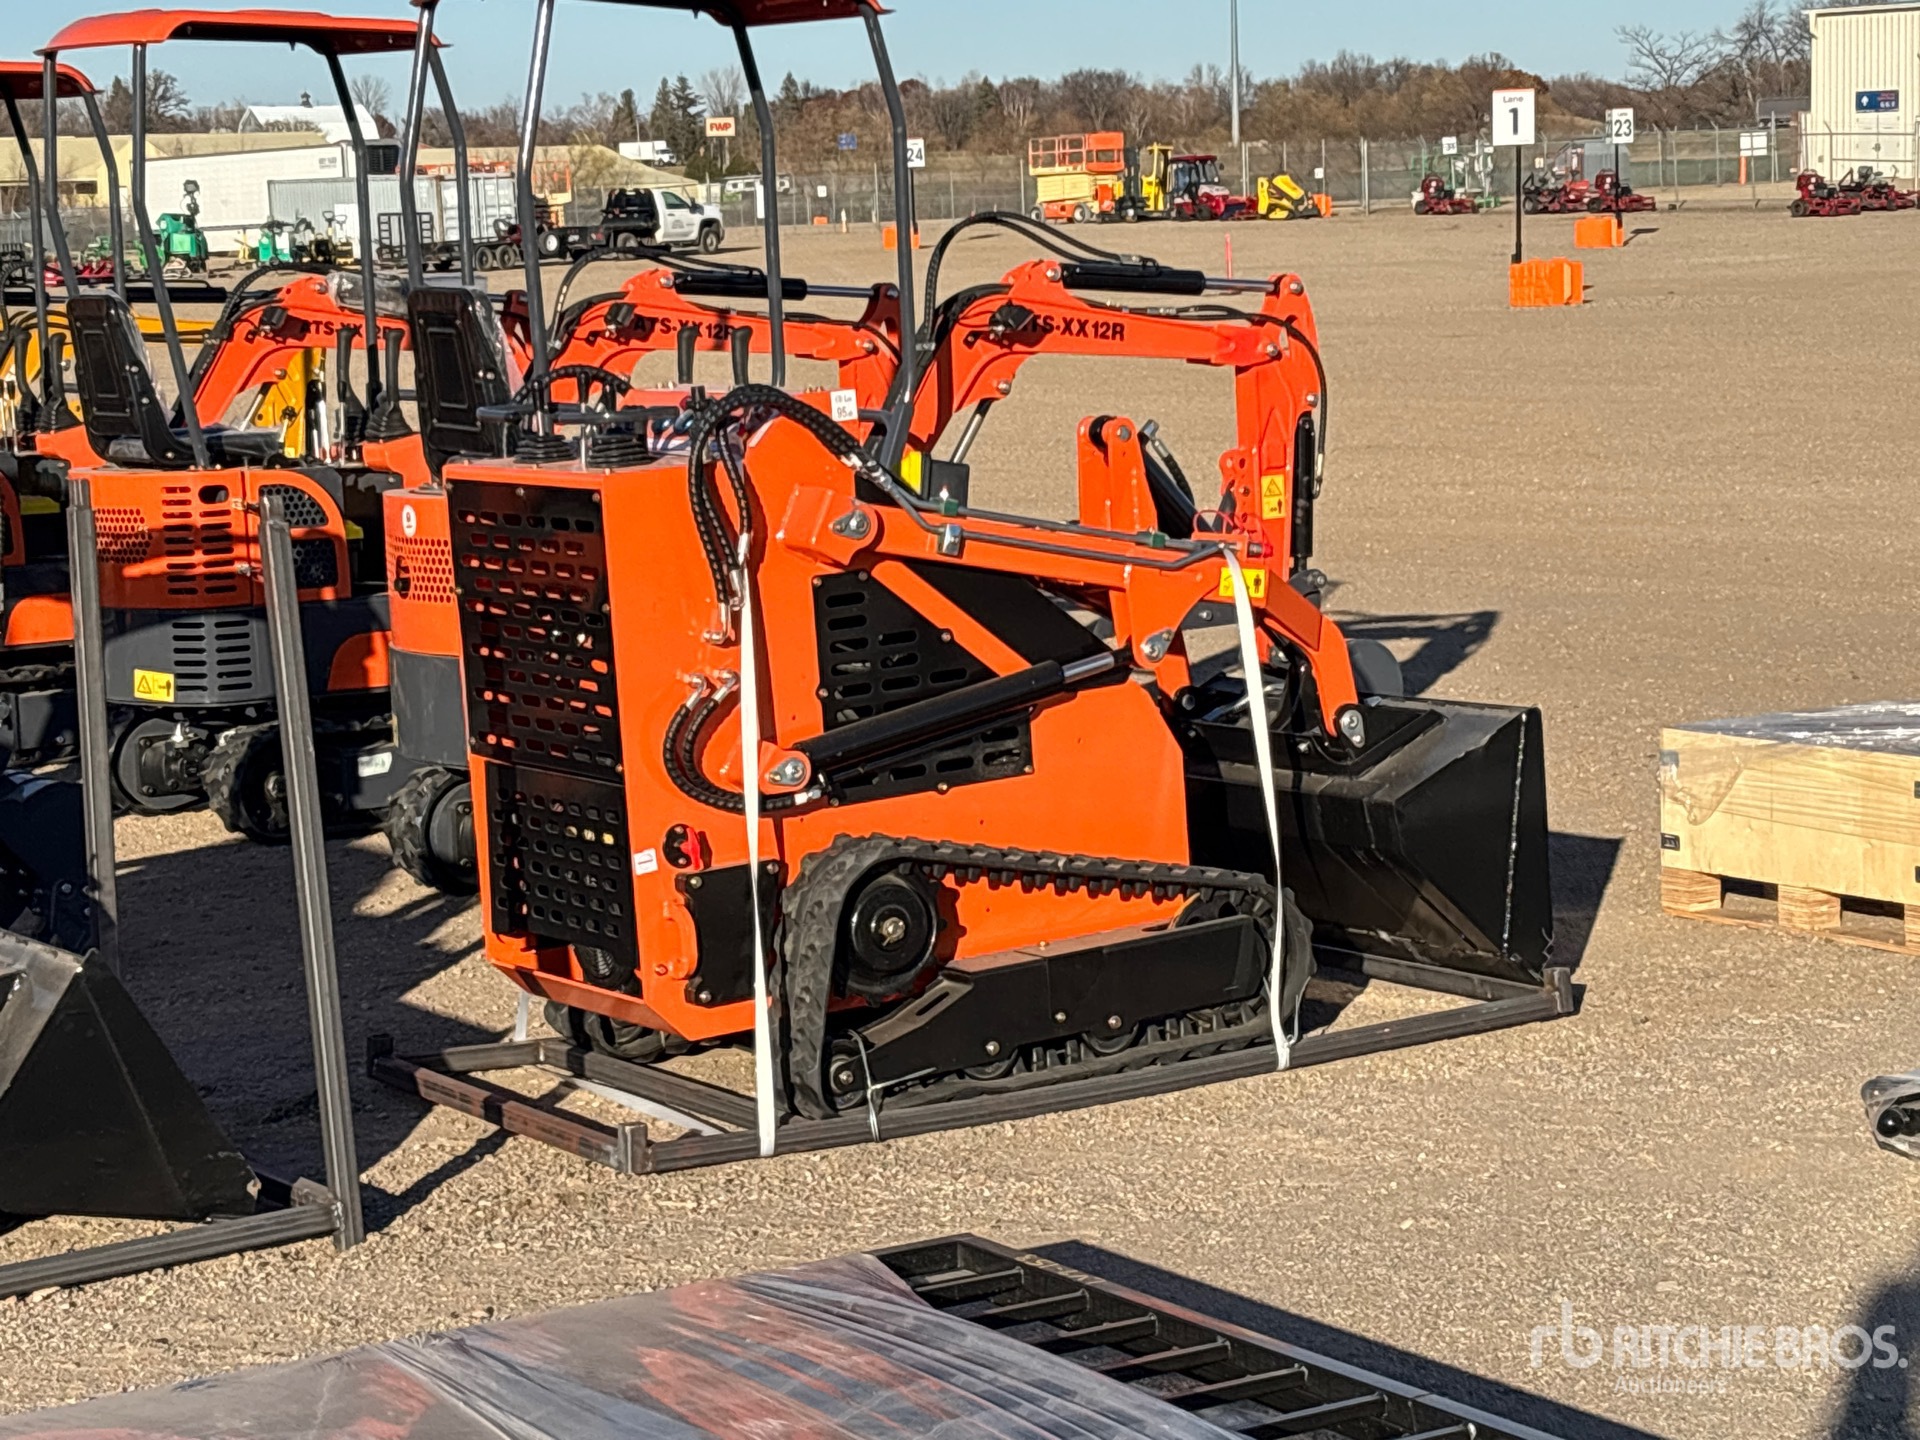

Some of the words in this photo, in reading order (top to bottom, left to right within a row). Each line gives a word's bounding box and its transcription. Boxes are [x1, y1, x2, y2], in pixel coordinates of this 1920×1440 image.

[710, 122, 731, 132] FWP
[1508, 107, 1518, 136] 1
[1614, 118, 1632, 137] 23
[907, 147, 923, 162] 24
[1021, 313, 1126, 342] TS-XX12R
